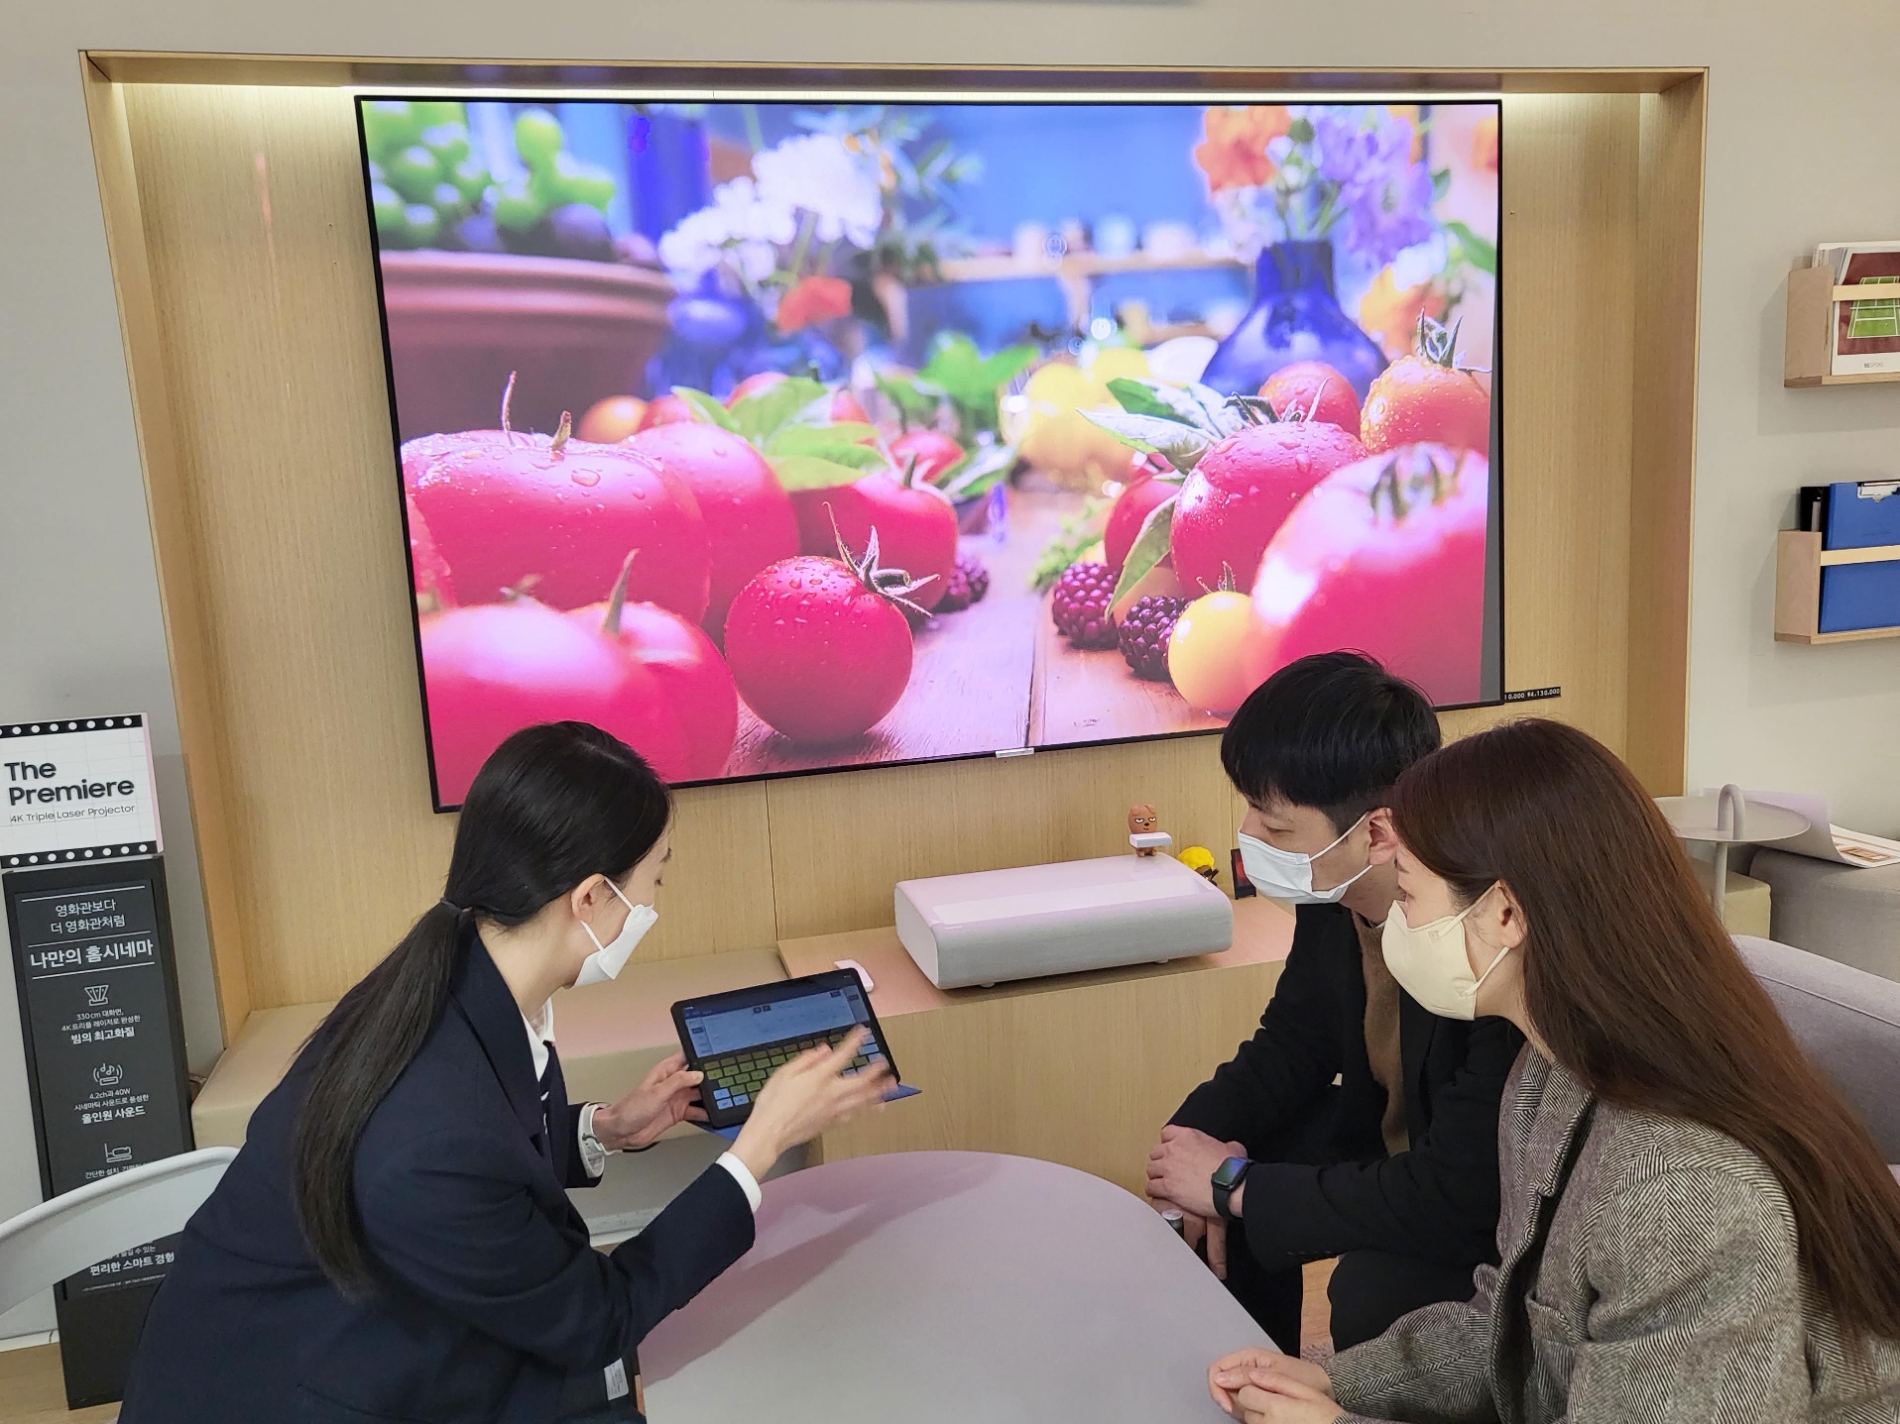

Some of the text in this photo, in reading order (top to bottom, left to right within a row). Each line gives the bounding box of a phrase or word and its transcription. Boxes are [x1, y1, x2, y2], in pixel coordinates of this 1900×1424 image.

[4, 761, 57, 781] The
[9, 779, 134, 806] Premiere
[11, 805, 136, 824] 4K Triple Laser Projector
[55, 898, 117, 918] 영화관보다
[50, 914, 126, 934] 더 영화관처럼
[30, 938, 154, 969] 나만의 홈시네마
[93, 1018, 120, 1028] 레이저로
[94, 1026, 135, 1041] 최고화질
[102, 1097, 129, 1107] 사운드로
[129, 1094, 149, 1103] 풍성한
[114, 1088, 131, 1096] 40W
[82, 1105, 146, 1125] 올인원 사운드
[85, 1168, 105, 1179] 간단한
[143, 1245, 156, 1254] 있는
[90, 1261, 121, 1276] 편리한
[123, 1256, 154, 1270] 스마트
[155, 1251, 175, 1265] 경험
